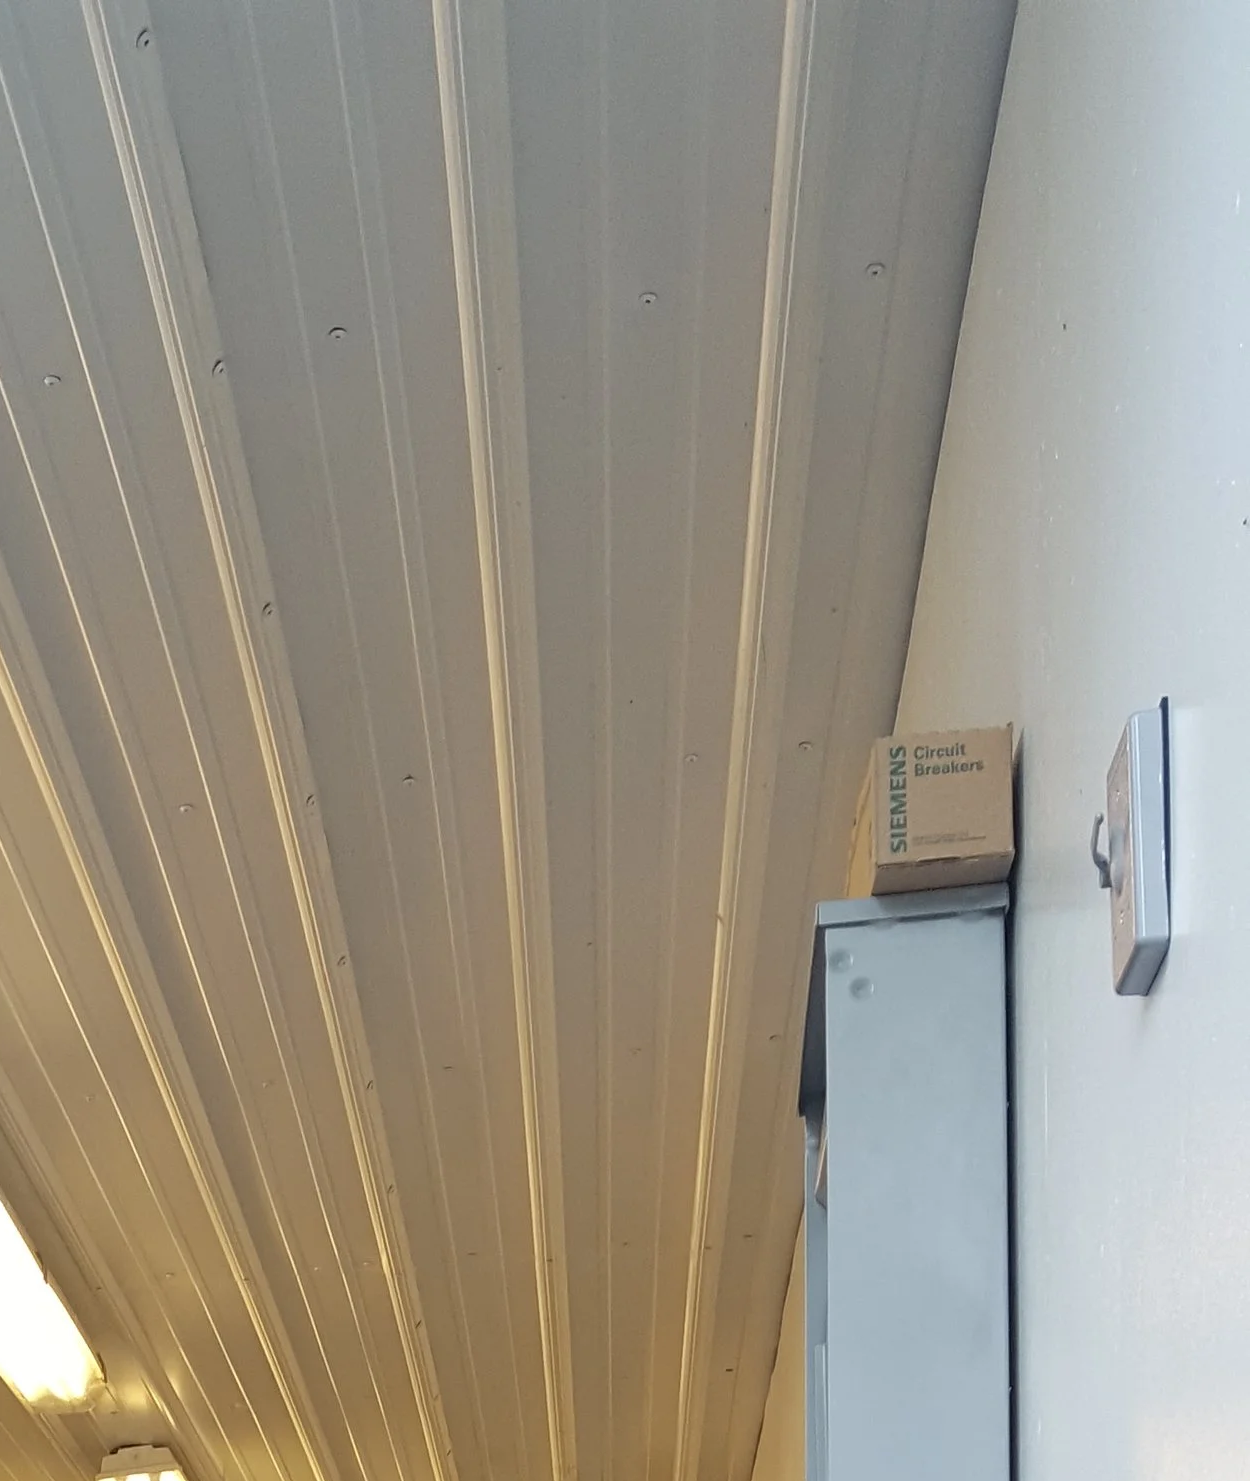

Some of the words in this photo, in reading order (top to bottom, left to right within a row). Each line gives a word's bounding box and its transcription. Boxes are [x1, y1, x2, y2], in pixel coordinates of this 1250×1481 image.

[913, 742, 966, 760] Circuit
[913, 759, 985, 777] Breakers
[889, 744, 908, 854] SIEMENS
